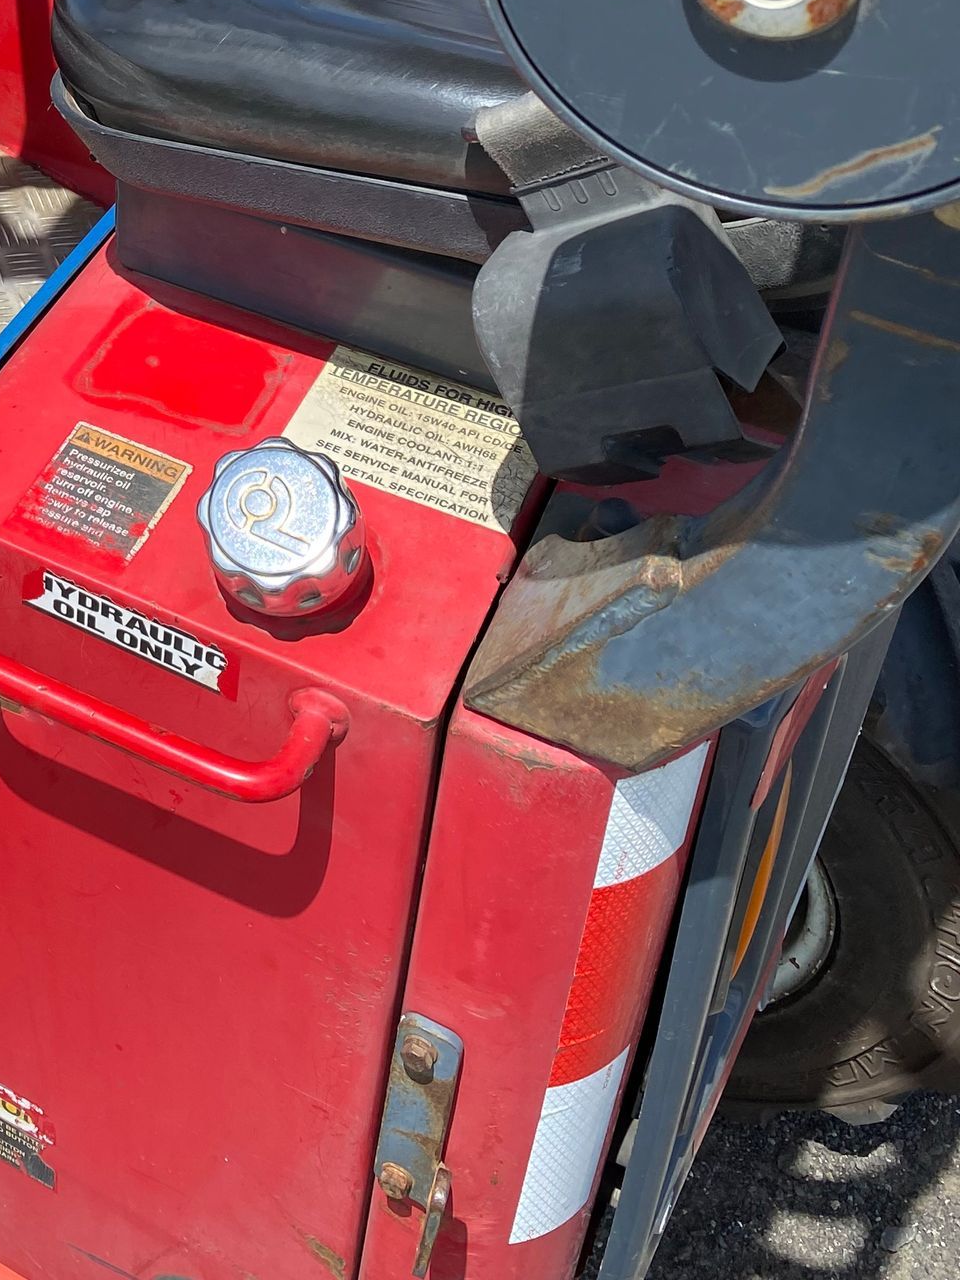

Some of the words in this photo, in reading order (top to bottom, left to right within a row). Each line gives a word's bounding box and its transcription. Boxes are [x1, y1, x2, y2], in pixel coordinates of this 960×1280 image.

[332, 366, 462, 415] TEMPERATURE
[367, 362, 430, 390] FLUIDS
[434, 384, 472, 404] FOR
[339, 386, 386, 408] ENGINE
[388, 404, 413, 417] OIL:
[458, 427, 480, 440] API
[482, 435, 524, 454] CD/CE
[349, 404, 422, 435] HYDRAULIC
[424, 430, 450, 444] OIL:
[452, 440, 497, 460] AWH68
[94, 436, 179, 479] WARNING
[330, 428, 356, 443] MIX:
[360, 440, 488, 490] WATER-ANTIFREEZE
[346, 419, 395, 441] ENGINE
[398, 436, 462, 464] COOLANT:
[56, 467, 107, 493] reservoir.
[62, 457, 114, 483] hydraulic
[115, 480, 132, 490] oil
[69, 448, 136, 480] Pressurized
[316, 440, 342, 454] SEE
[343, 449, 400, 474] SERVICE
[401, 470, 456, 496] MANUAL
[460, 490, 489, 506] FOR
[52, 475, 75, 491] Turn
[76, 486, 94, 498] off
[94, 494, 135, 516] engine.
[90, 504, 112, 518] cap
[342, 464, 385, 487] DETAIL
[388, 482, 489, 522] SPECIFICATION
[73, 508, 86, 519] to
[87, 514, 129, 537] release
[80, 524, 106, 538] and
[53, 598, 106, 636] OIL
[116, 628, 204, 677] ONLY
[5, 1124, 17, 1134] BE
[5, 1132, 38, 1152] BUTTON
